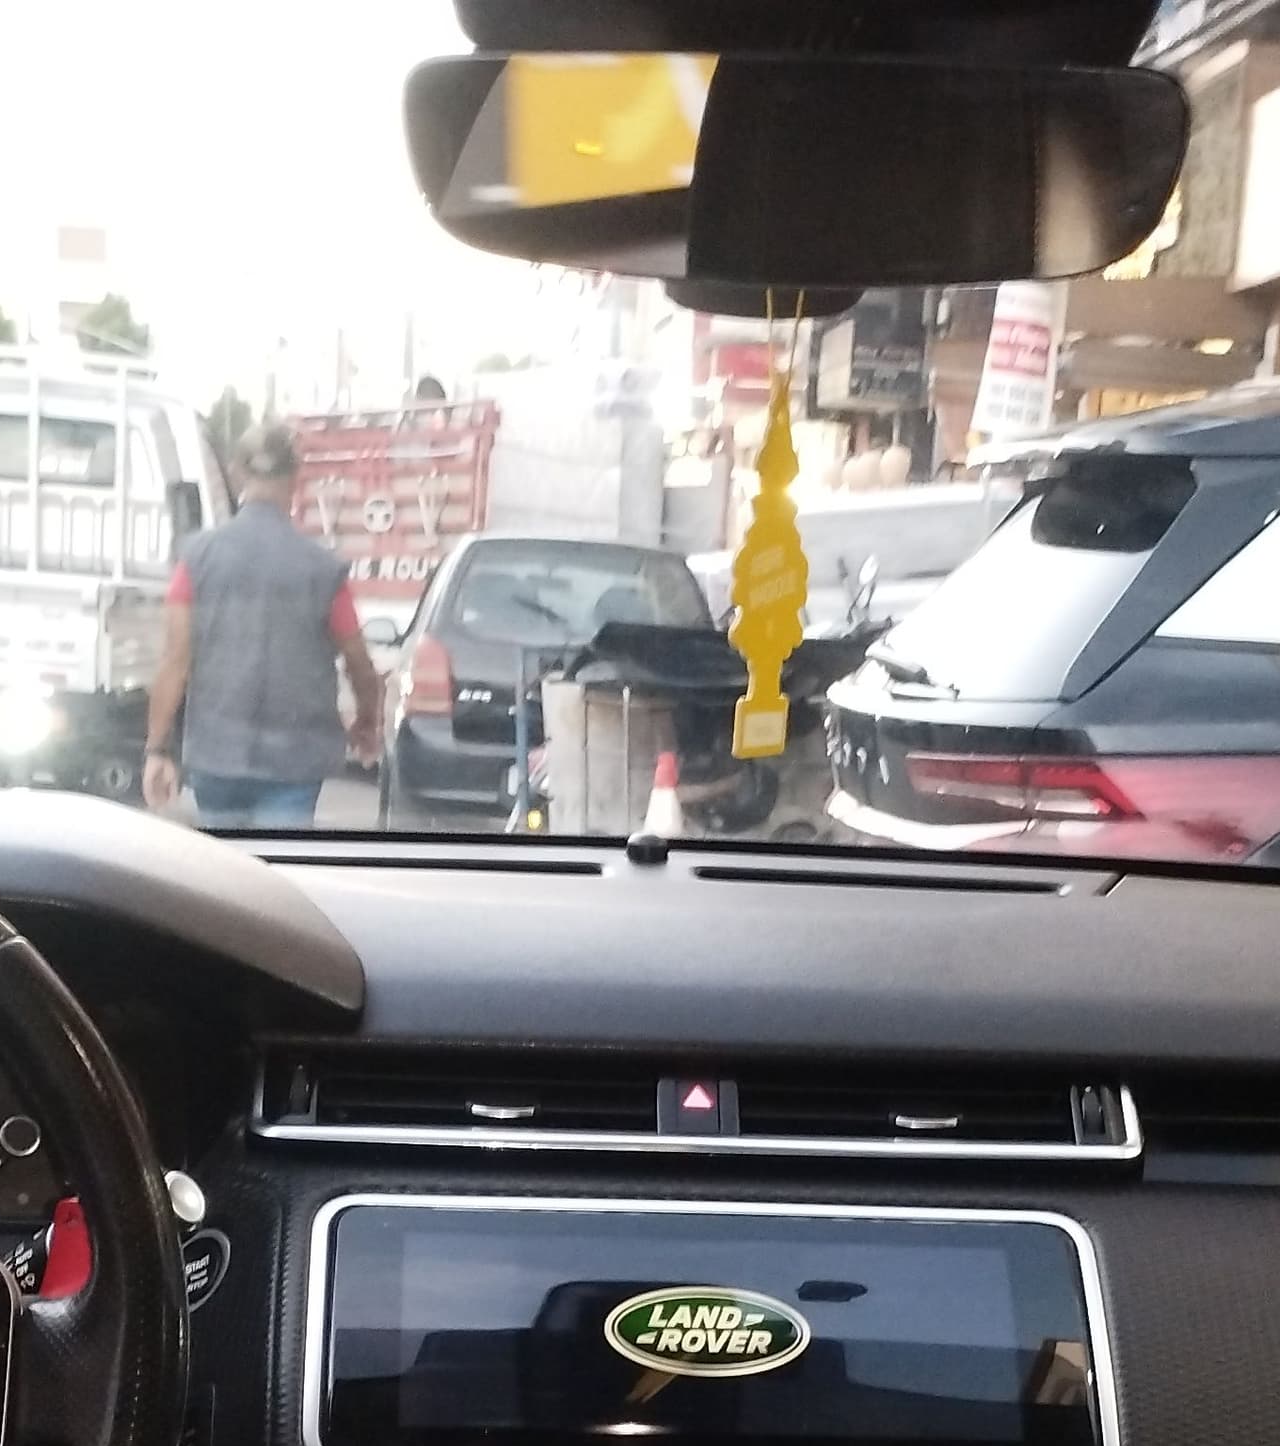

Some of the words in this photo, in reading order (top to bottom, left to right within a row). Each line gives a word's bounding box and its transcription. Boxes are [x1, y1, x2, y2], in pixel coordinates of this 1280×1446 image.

[185, 1253, 210, 1275] START
[648, 1304, 742, 1329] LAND
[656, 1328, 773, 1354] ROVER
